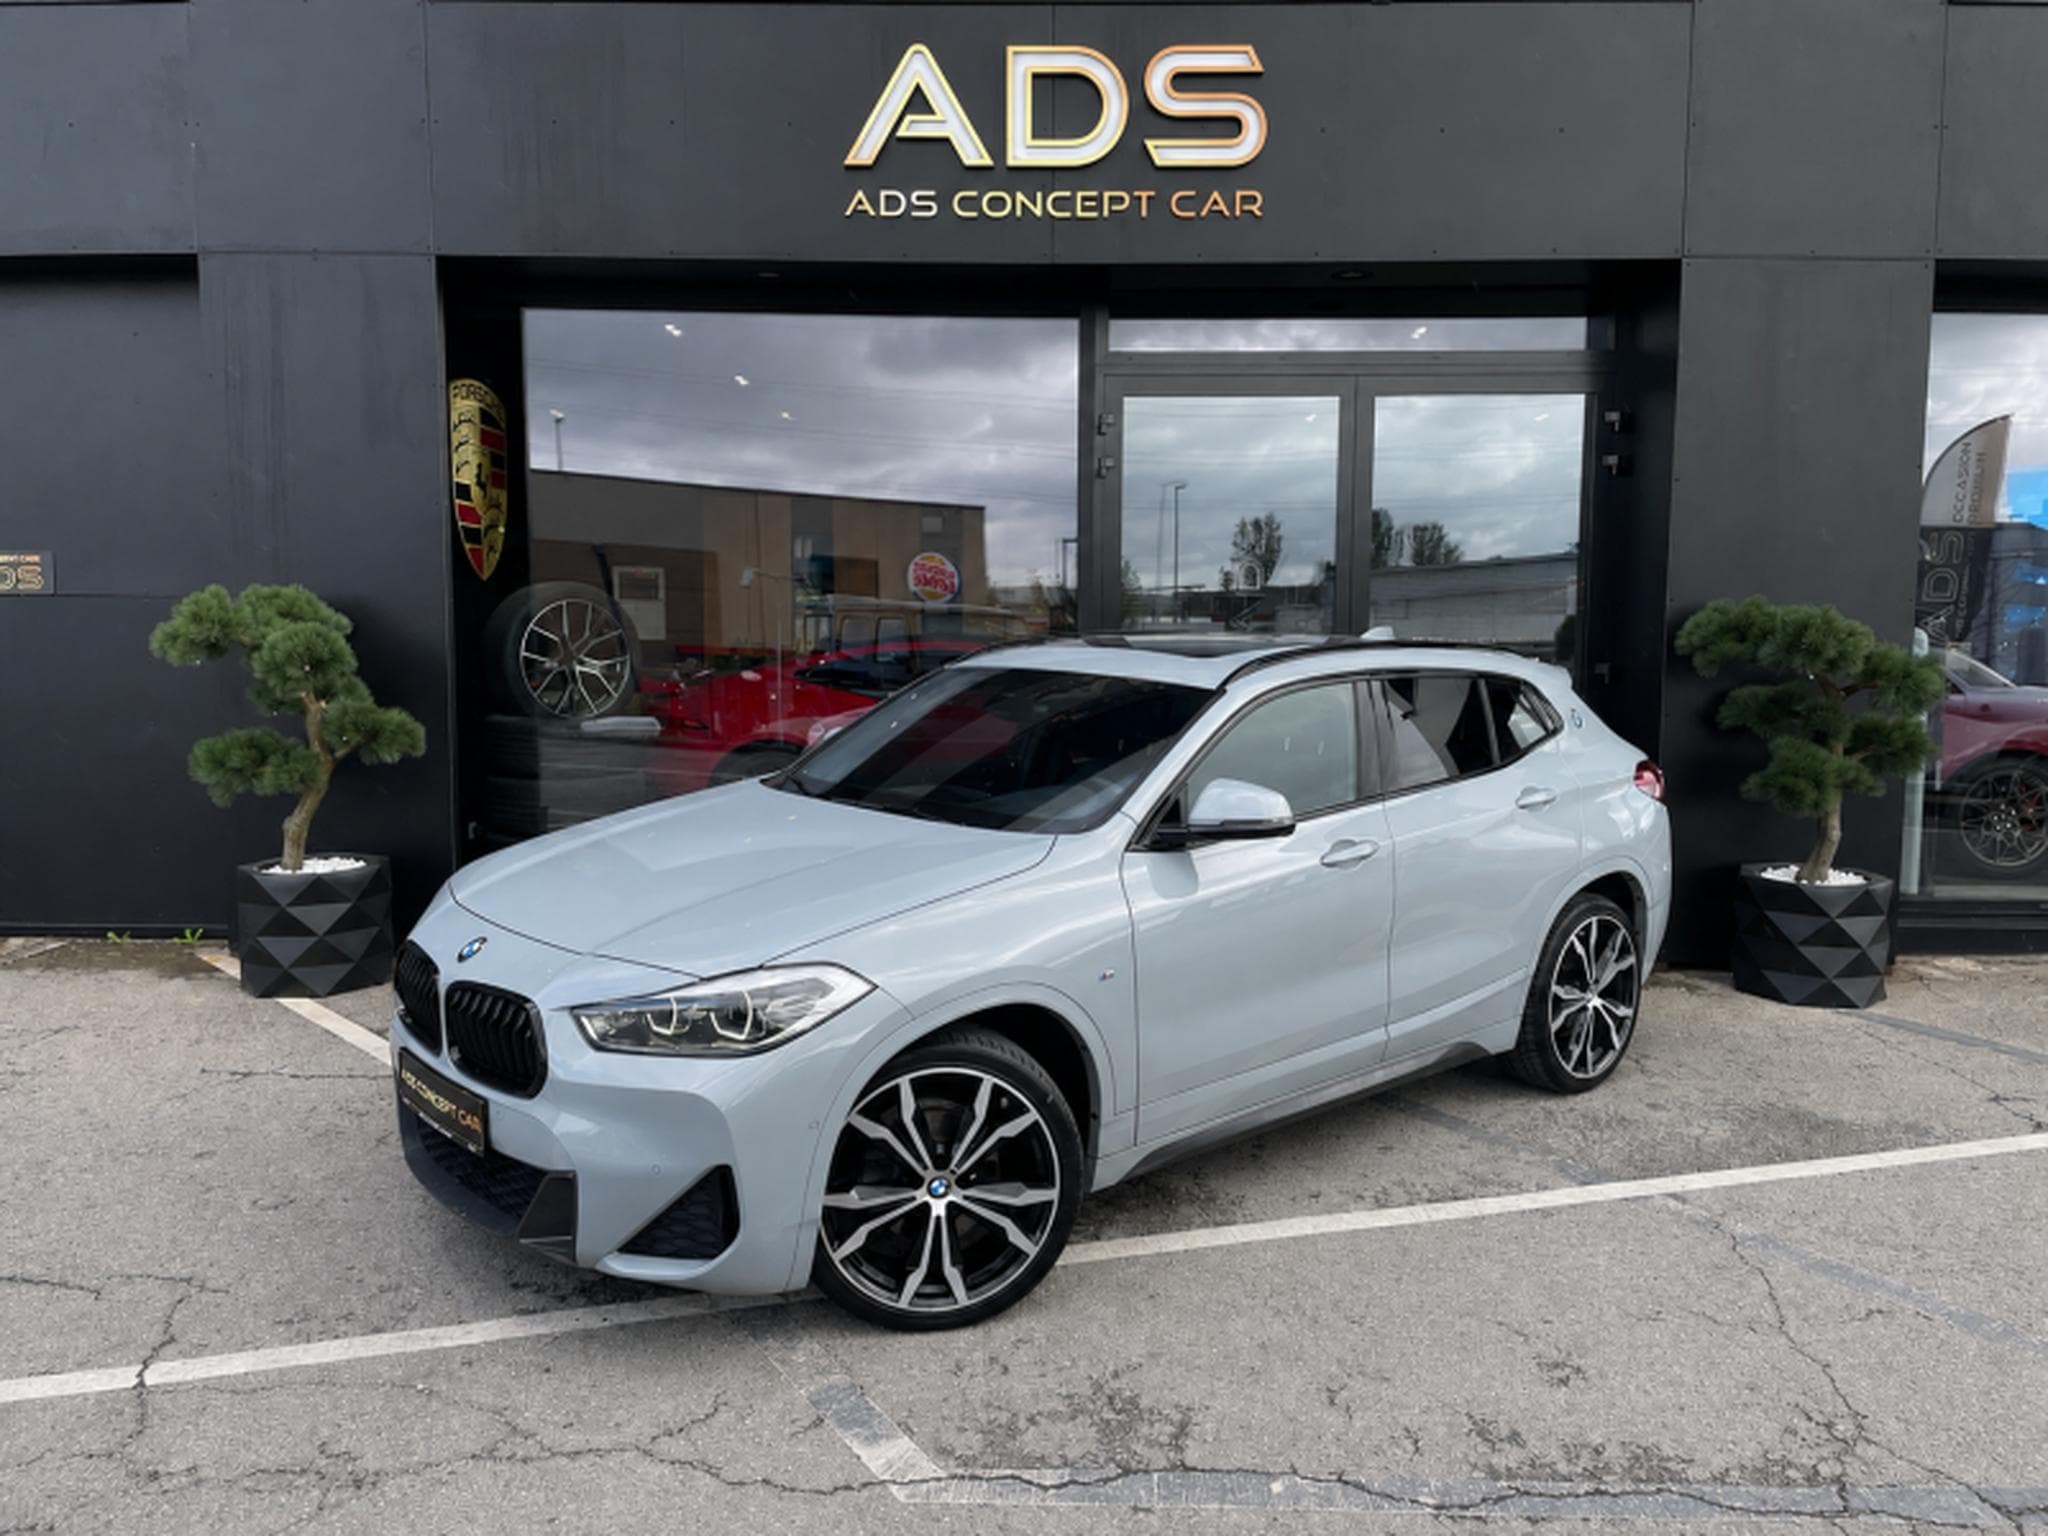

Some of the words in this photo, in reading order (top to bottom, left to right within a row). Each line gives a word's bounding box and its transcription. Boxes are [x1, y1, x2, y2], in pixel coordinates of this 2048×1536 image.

[843, 42, 1268, 167] ADS
[844, 189, 938, 218] ADS
[953, 190, 1156, 219] CONCEPT
[1170, 190, 1264, 218] CAR
